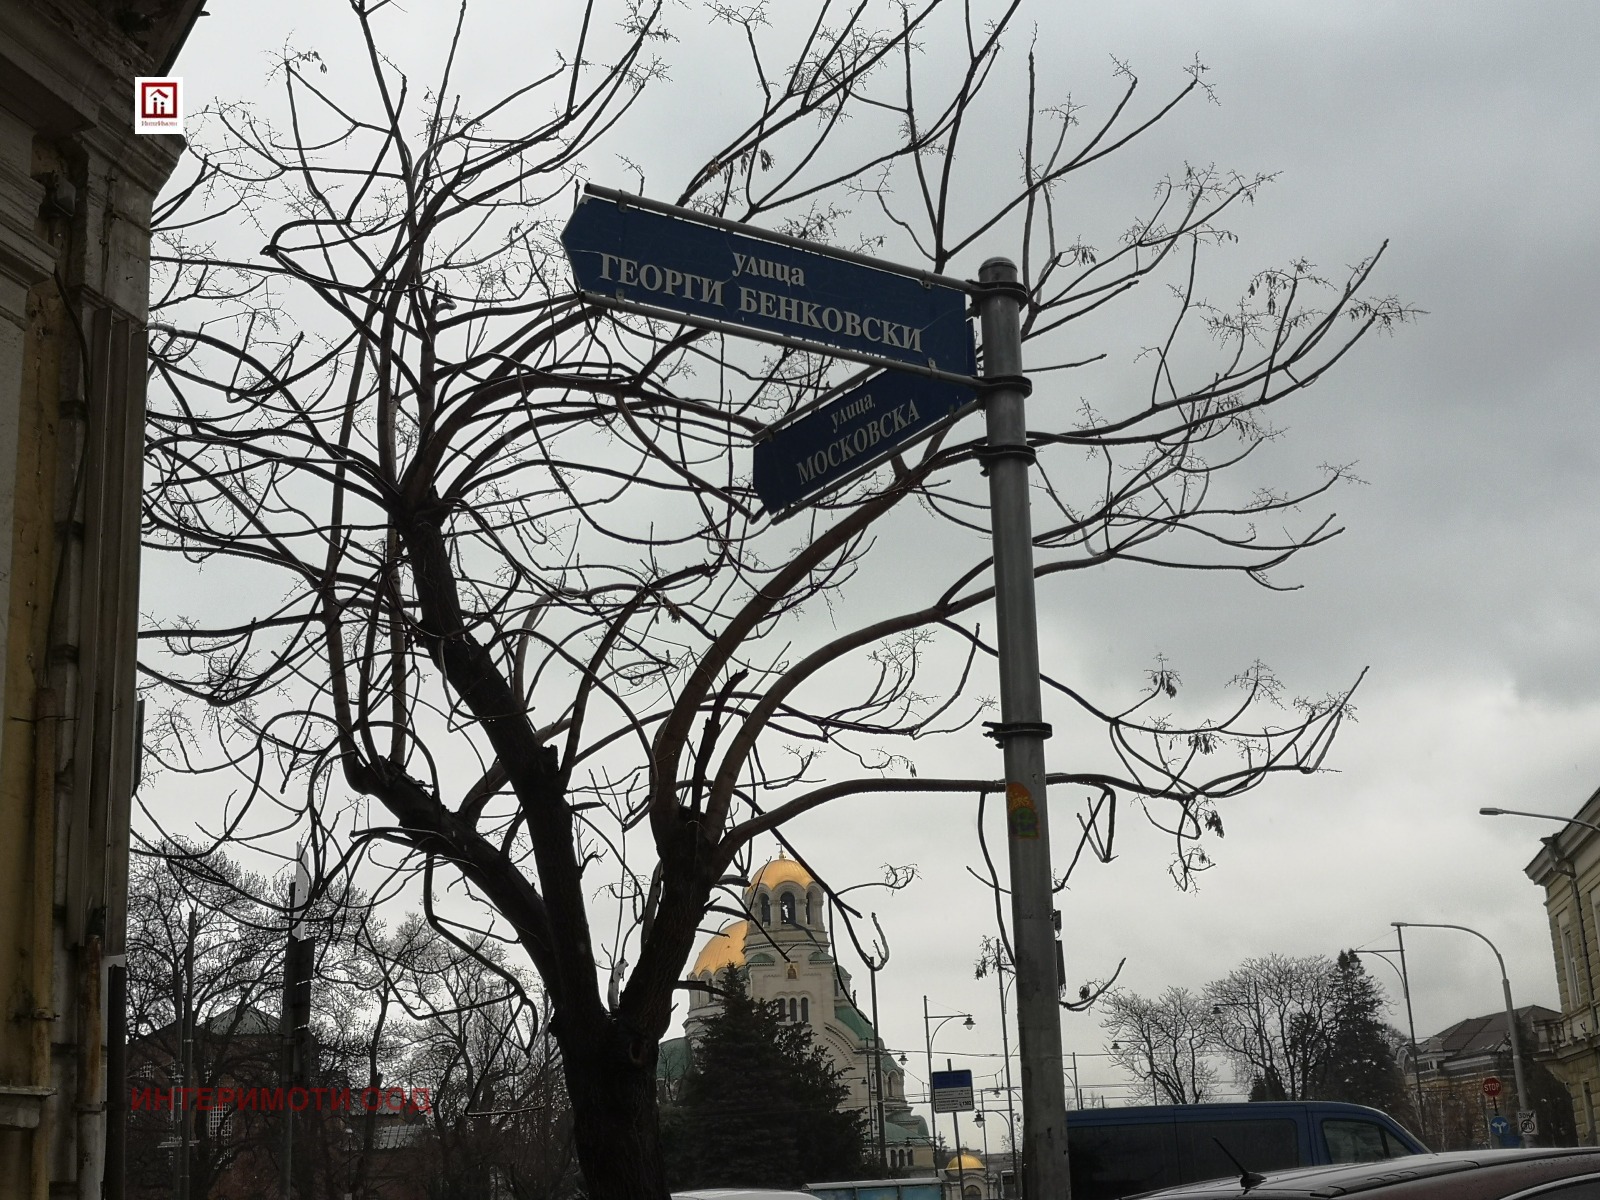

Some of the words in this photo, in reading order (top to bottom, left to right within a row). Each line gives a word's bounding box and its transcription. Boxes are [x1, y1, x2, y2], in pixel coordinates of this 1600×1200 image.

[732, 252, 805, 287] улица
[600, 252, 724, 307] ГЕОРГИ
[739, 286, 923, 353] БЕНКОВСКИ
[796, 399, 921, 486] МОСКОВСКА
[1484, 1083, 1500, 1092] STOP
